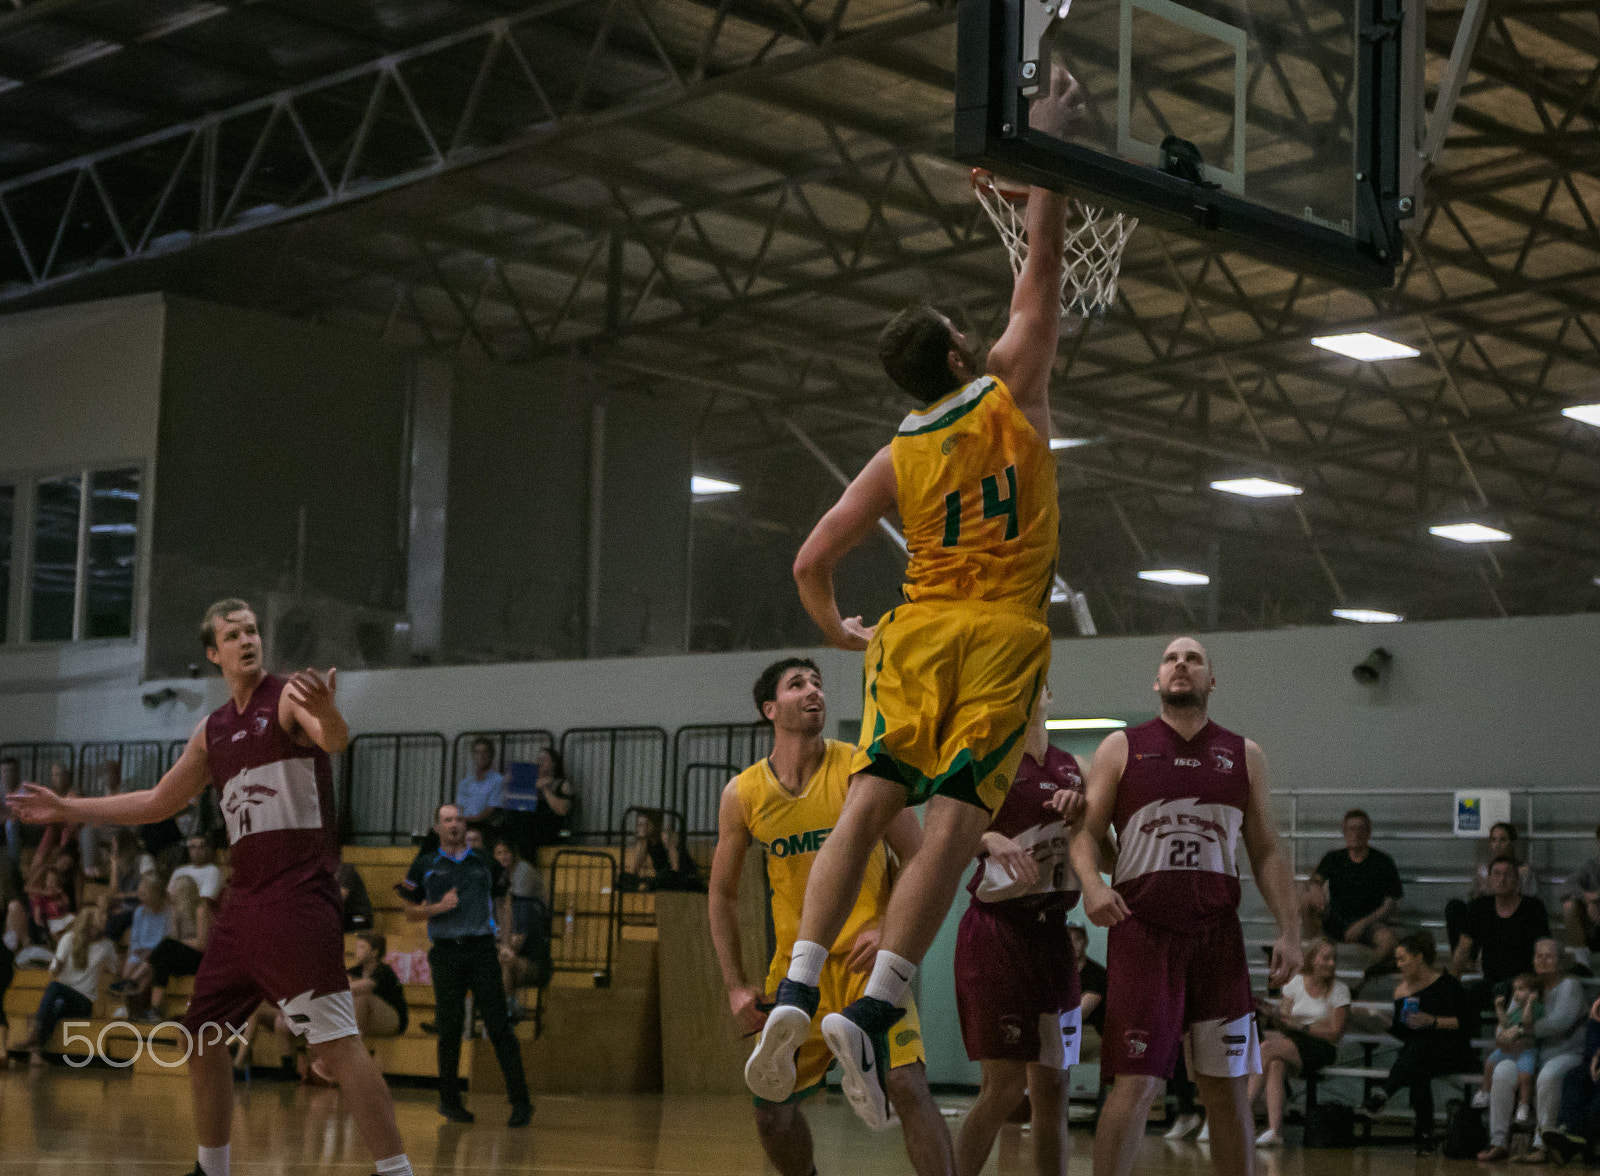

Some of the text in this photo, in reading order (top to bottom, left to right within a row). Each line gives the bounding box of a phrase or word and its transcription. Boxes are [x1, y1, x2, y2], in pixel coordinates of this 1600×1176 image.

[942, 464, 1020, 547] 14
[760, 827, 834, 859] OME
[1169, 839, 1201, 867] 22
